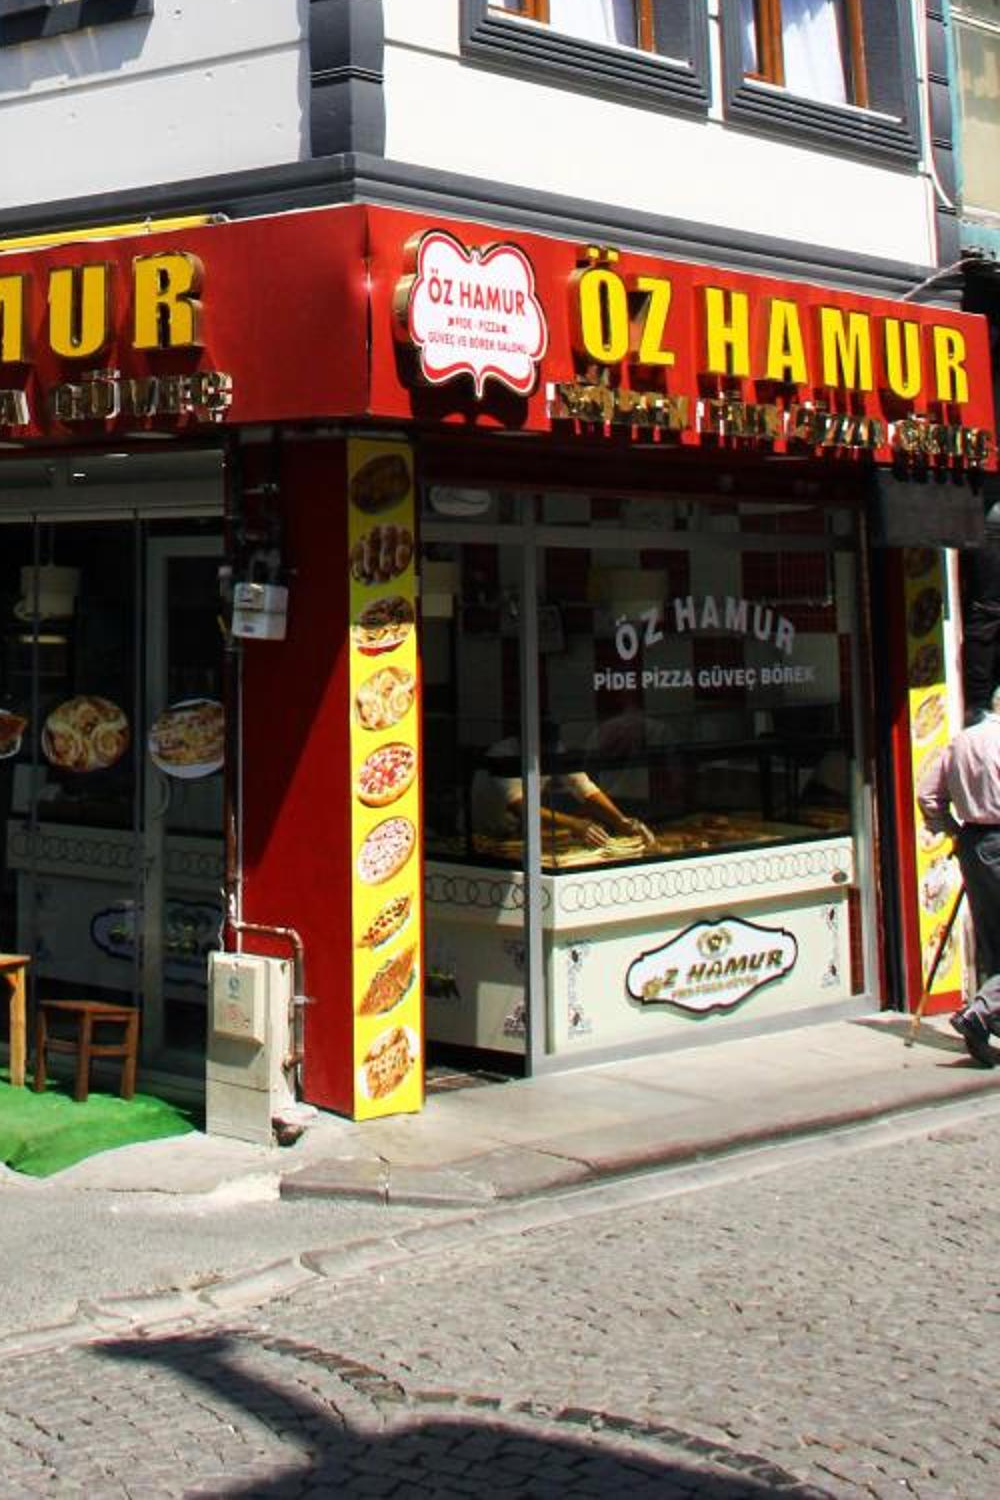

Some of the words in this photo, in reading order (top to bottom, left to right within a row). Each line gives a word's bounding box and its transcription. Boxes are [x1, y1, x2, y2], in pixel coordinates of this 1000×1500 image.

[428, 268, 453, 305] ÖZ
[459, 281, 525, 316] HAMUR
[579, 247, 675, 366] ÖZ
[704, 286, 969, 404] HAMUR
[615, 607, 664, 661] ÖZ
[674, 595, 796, 656] HAMUR
[593, 667, 637, 691] PİDE
[642, 666, 694, 689] PİZZA
[699, 664, 756, 691] GÜVEÇ
[761, 661, 816, 685] BÖREK
[688, 949, 783, 982] HAMUR
